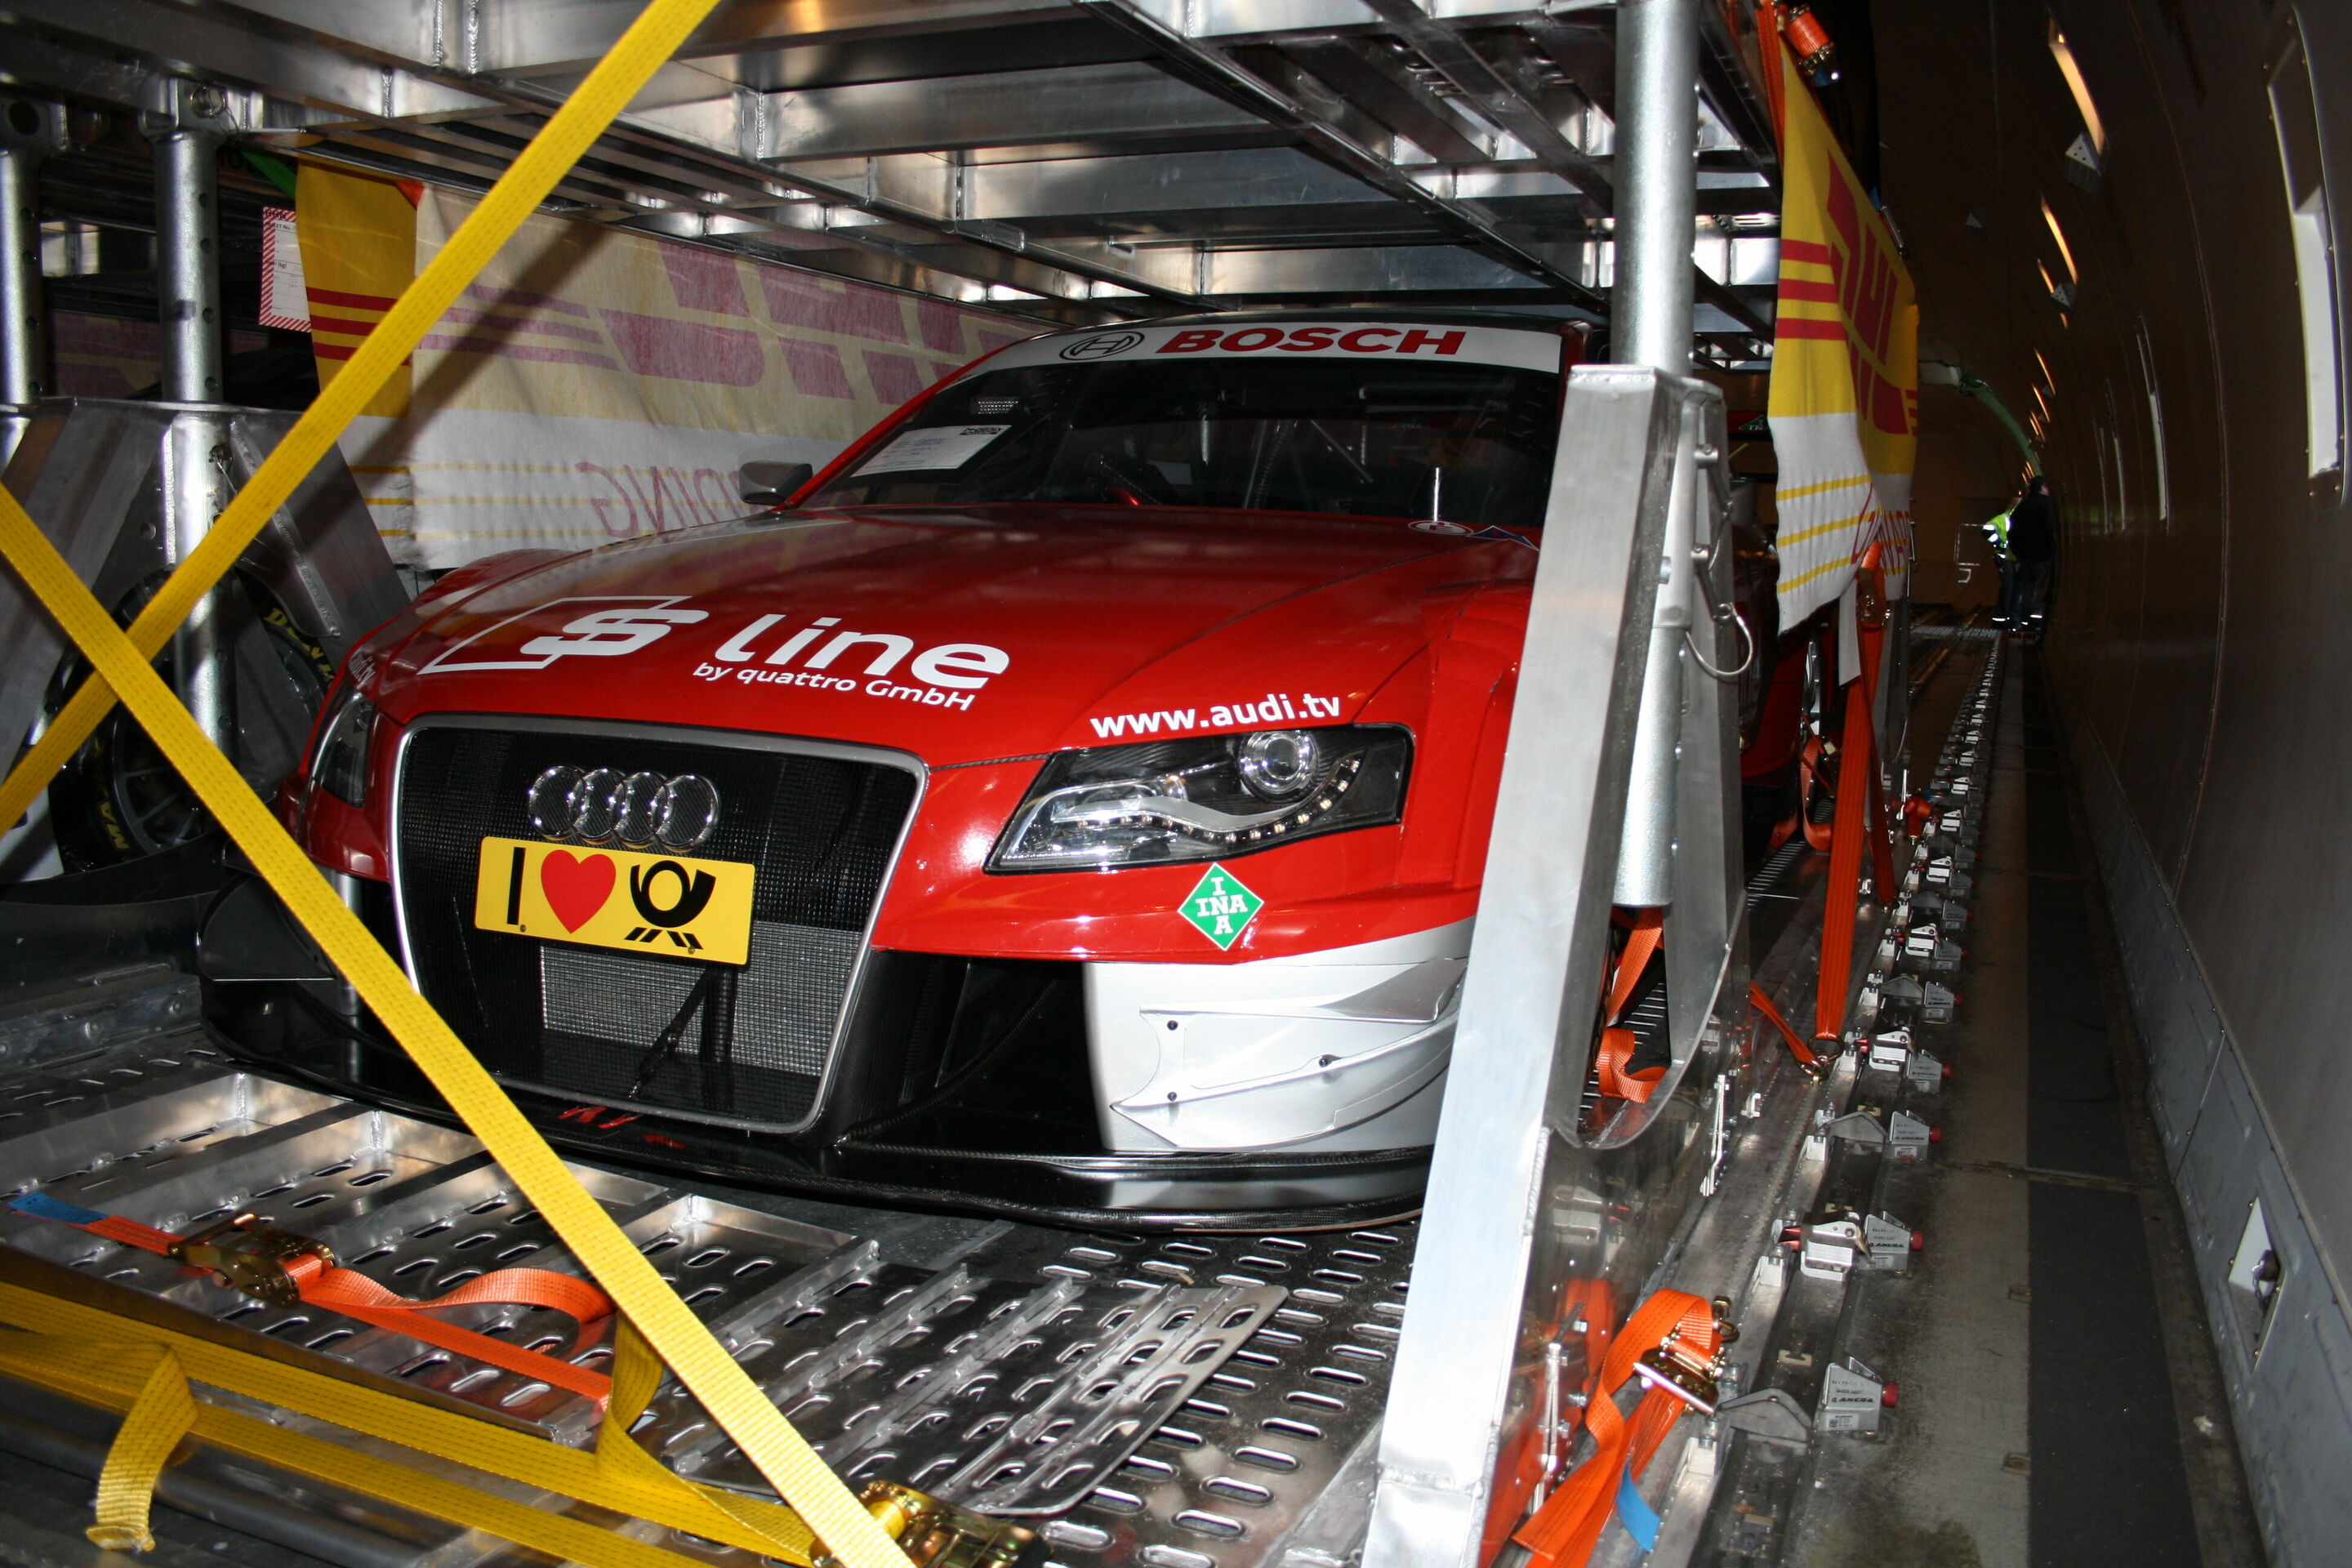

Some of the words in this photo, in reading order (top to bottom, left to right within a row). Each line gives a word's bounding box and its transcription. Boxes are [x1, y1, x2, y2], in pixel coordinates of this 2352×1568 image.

[1155, 327, 1467, 355] BOSCH
[715, 613, 1010, 689] line
[693, 662, 733, 682] by
[737, 668, 857, 692] quattro
[865, 679, 975, 711] GmbH
[1090, 693, 1341, 739] www.audi.tv
[1195, 893, 1248, 917] INA
